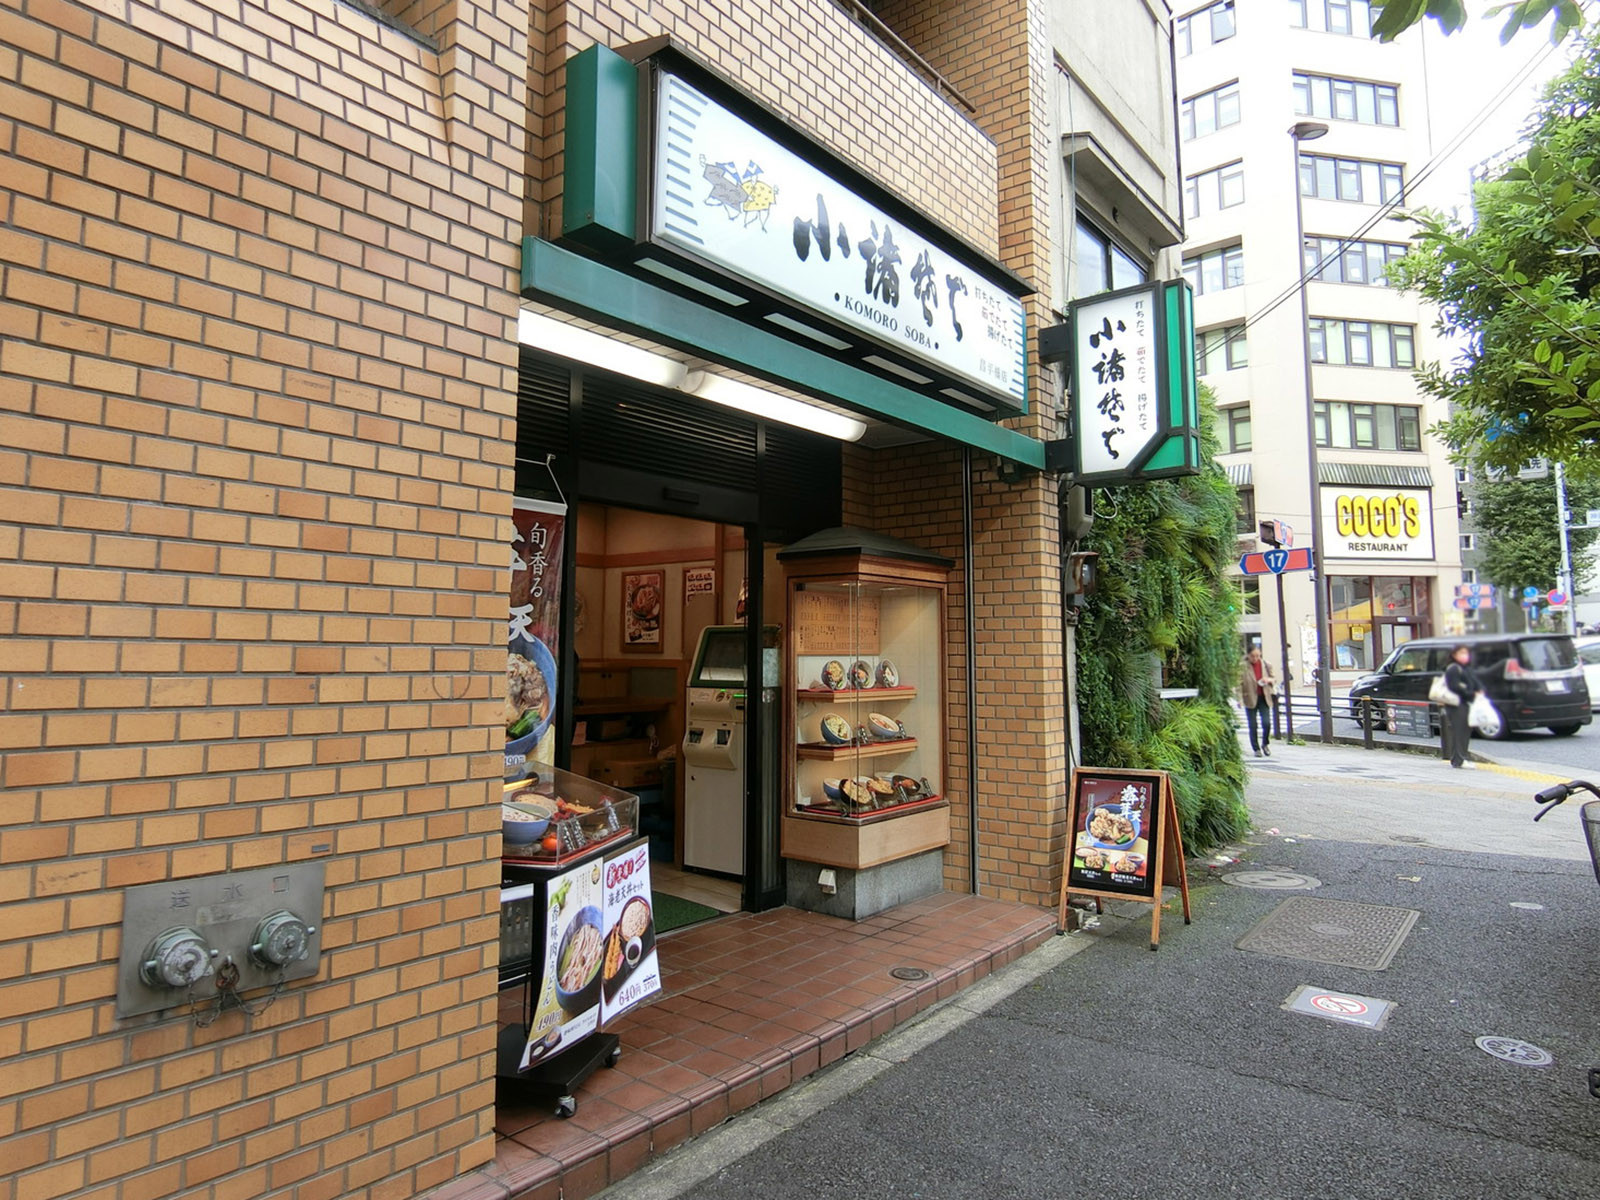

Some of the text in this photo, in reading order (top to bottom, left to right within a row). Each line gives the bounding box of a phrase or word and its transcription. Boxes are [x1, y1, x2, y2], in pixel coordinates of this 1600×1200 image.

[975, 286, 1001, 312] 打ちたて
[844, 295, 932, 349] KOMORO SOBA
[1135, 300, 1145, 337] 打ちたて
[1335, 493, 1420, 538] COCO'S
[528, 522, 549, 598] 旬香る
[1348, 542, 1408, 552] RESTAURANT
[1268, 553, 1285, 568] 17
[619, 983, 641, 1006] 640円
[535, 1010, 562, 1032] 490円
